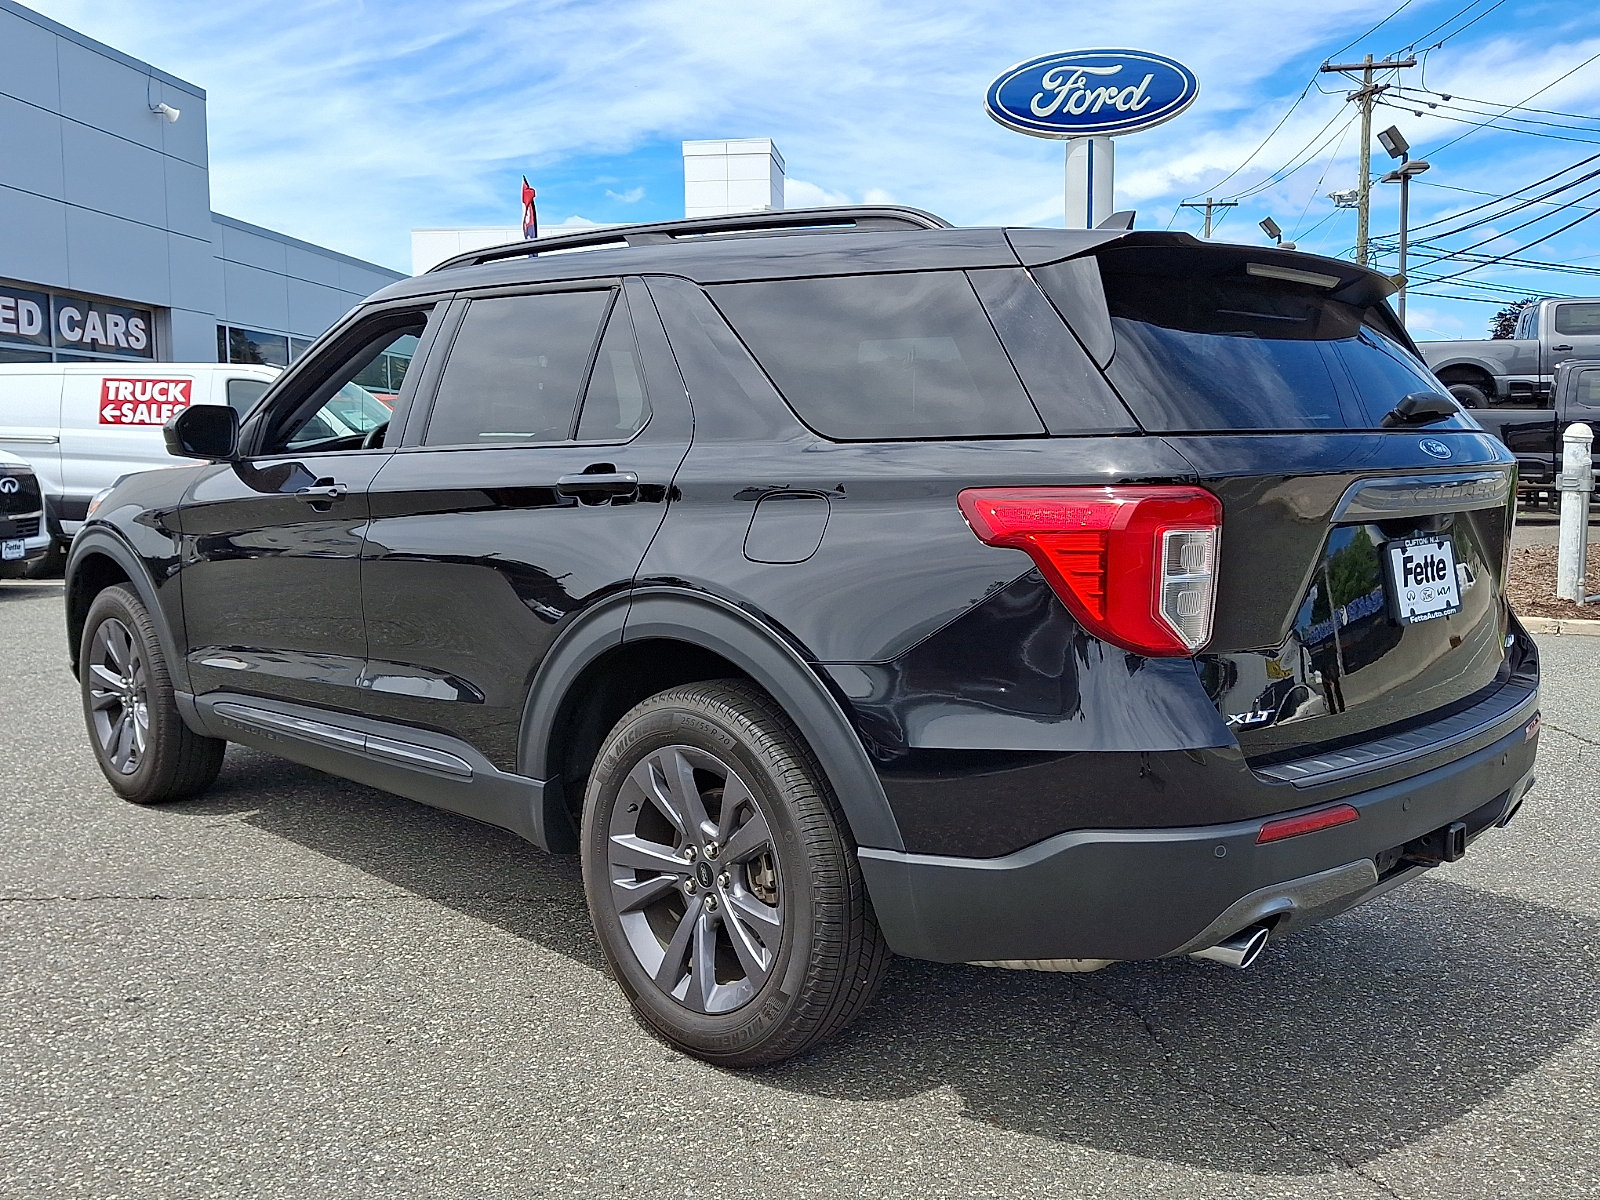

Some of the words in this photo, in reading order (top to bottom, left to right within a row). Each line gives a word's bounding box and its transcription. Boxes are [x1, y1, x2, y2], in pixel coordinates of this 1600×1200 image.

[1030, 64, 1155, 117] Ford
[59, 306, 147, 350] CARS
[105, 380, 187, 403] TRUCK
[1402, 554, 1447, 588] Fette
[1409, 608, 1457, 624] FetteAuto.com
[1225, 709, 1276, 726] XLT
